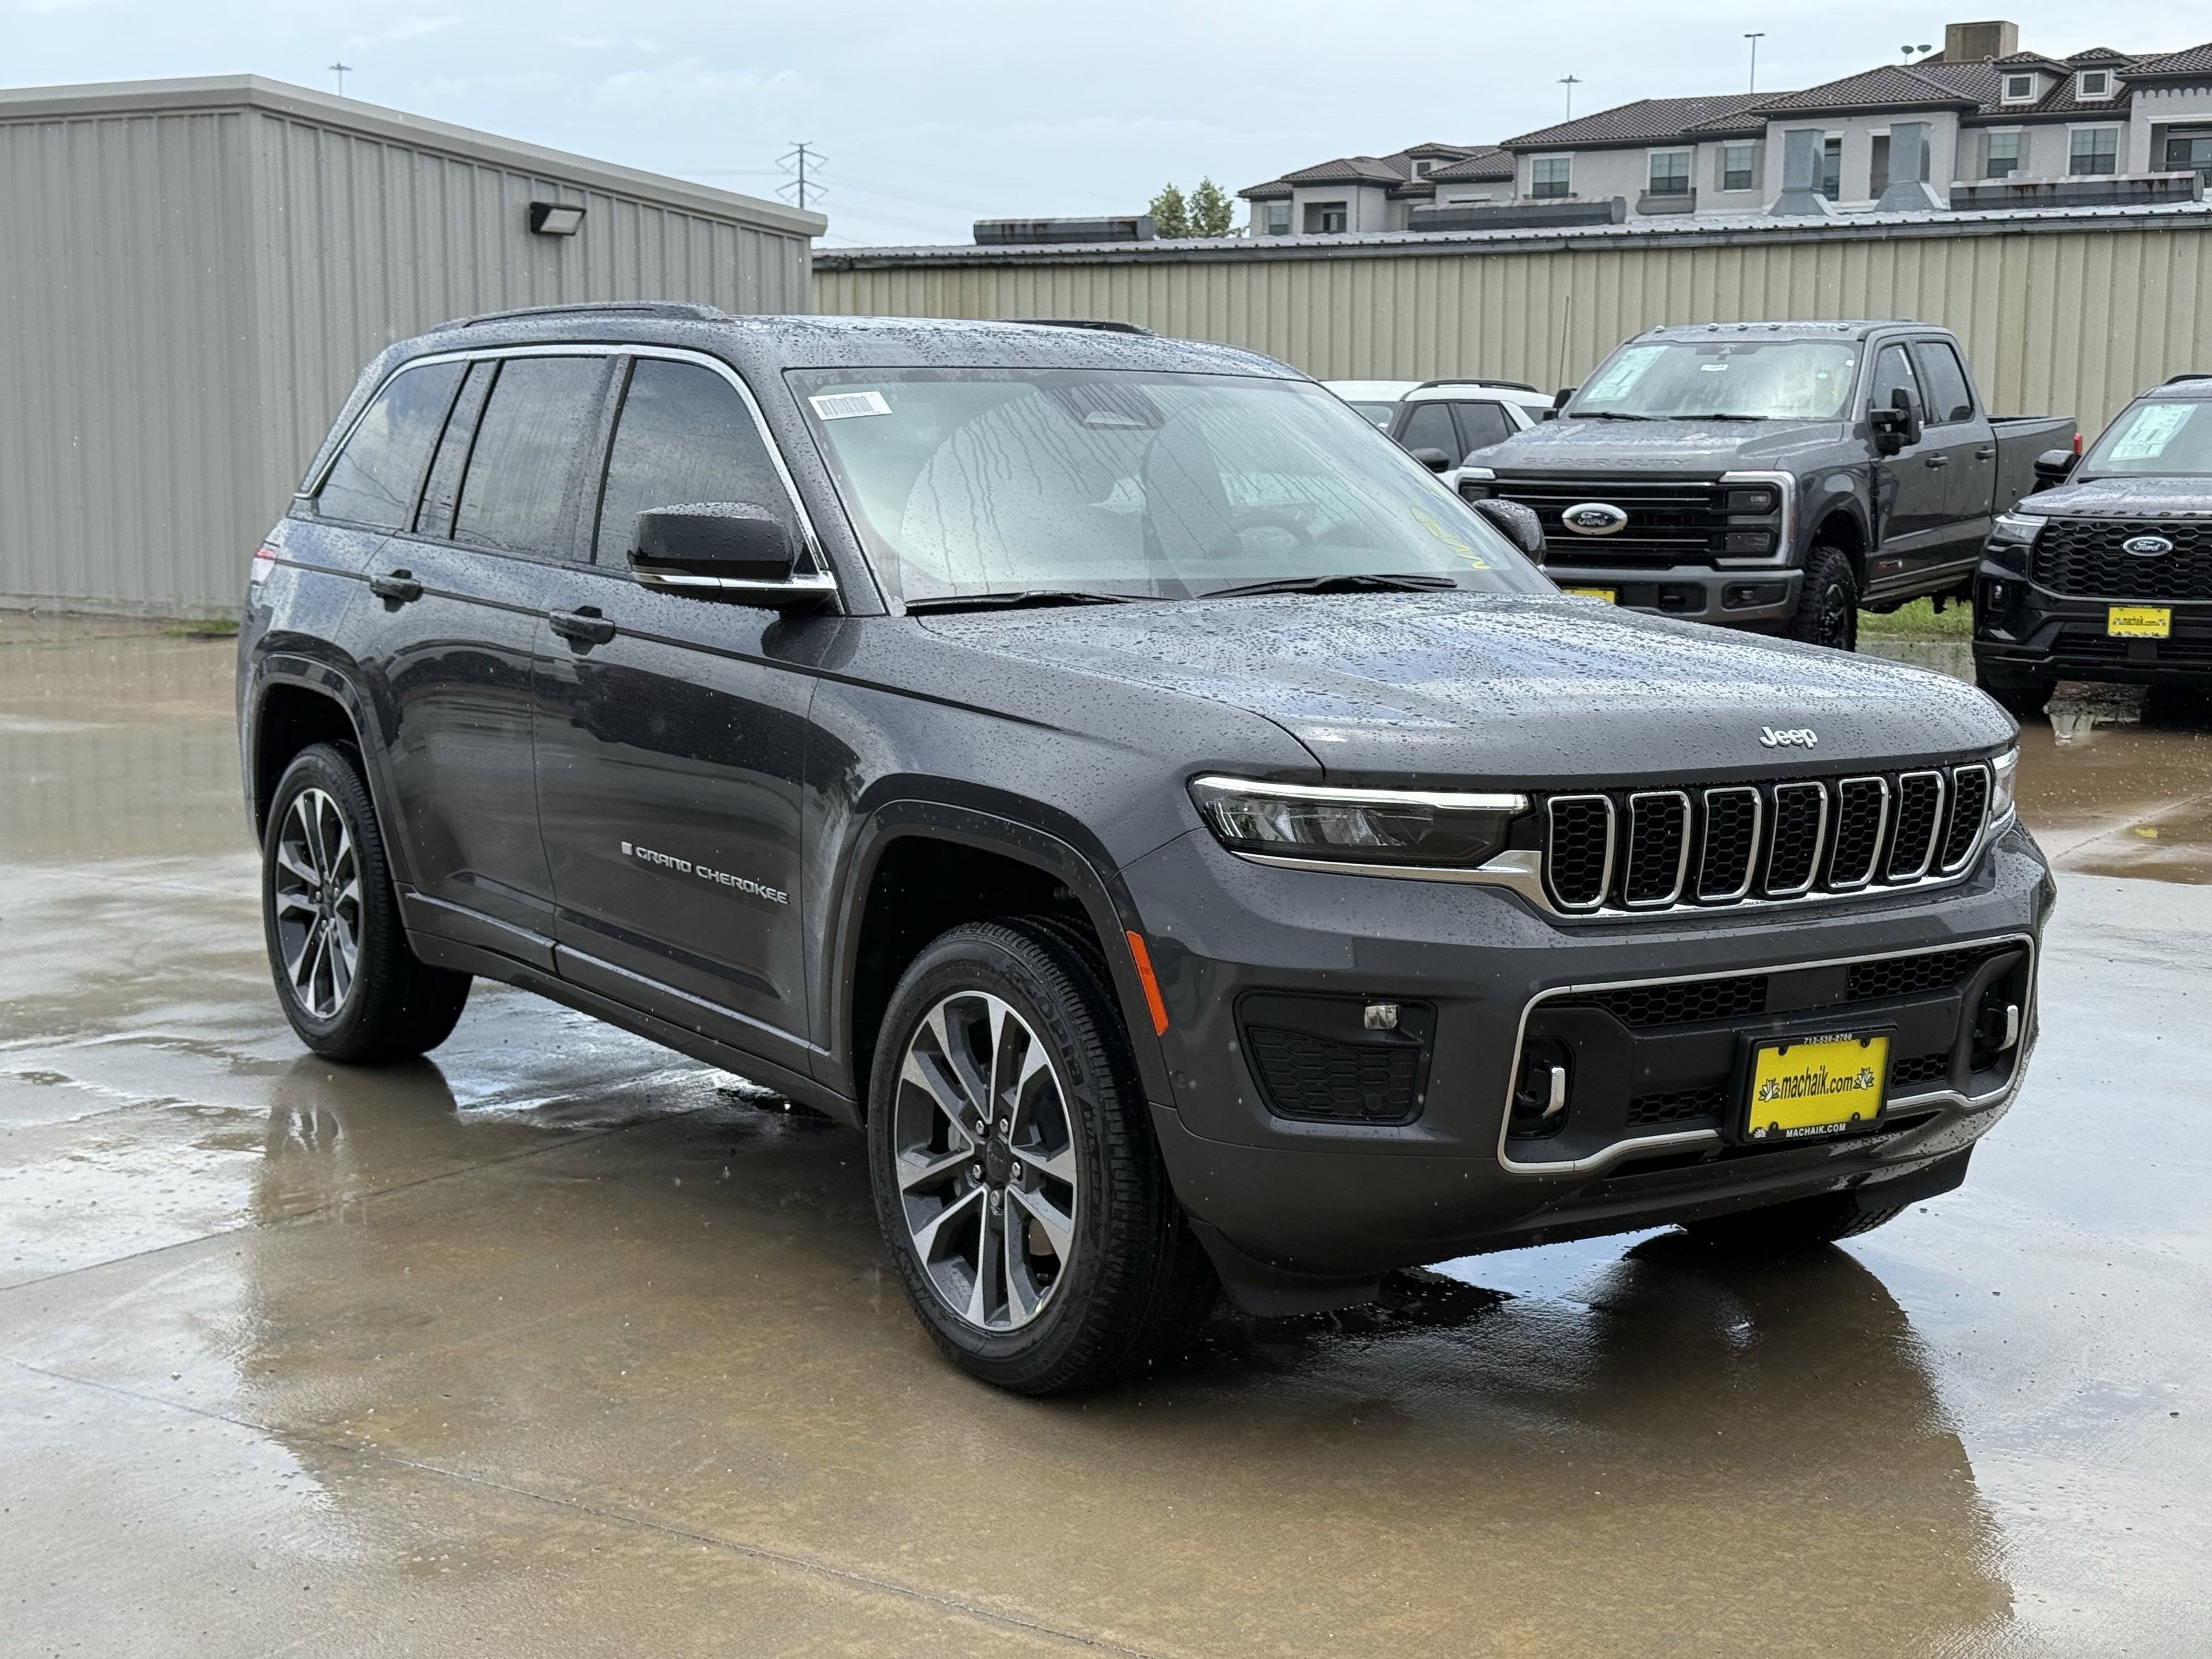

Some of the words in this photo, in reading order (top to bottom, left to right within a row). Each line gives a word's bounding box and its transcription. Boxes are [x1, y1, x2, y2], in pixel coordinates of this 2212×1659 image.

[1520, 456, 1611, 468] SUPER
[1616, 458, 1691, 469] DUTY
[2134, 540, 2163, 551] Ford
[1758, 726, 1818, 749] Jeep
[635, 847, 692, 873] GRAND
[696, 865, 790, 905] CHEROKEE
[1780, 1065, 1853, 1099] machaik.com
[1786, 1123, 1846, 1138] MACHAIK.COM
